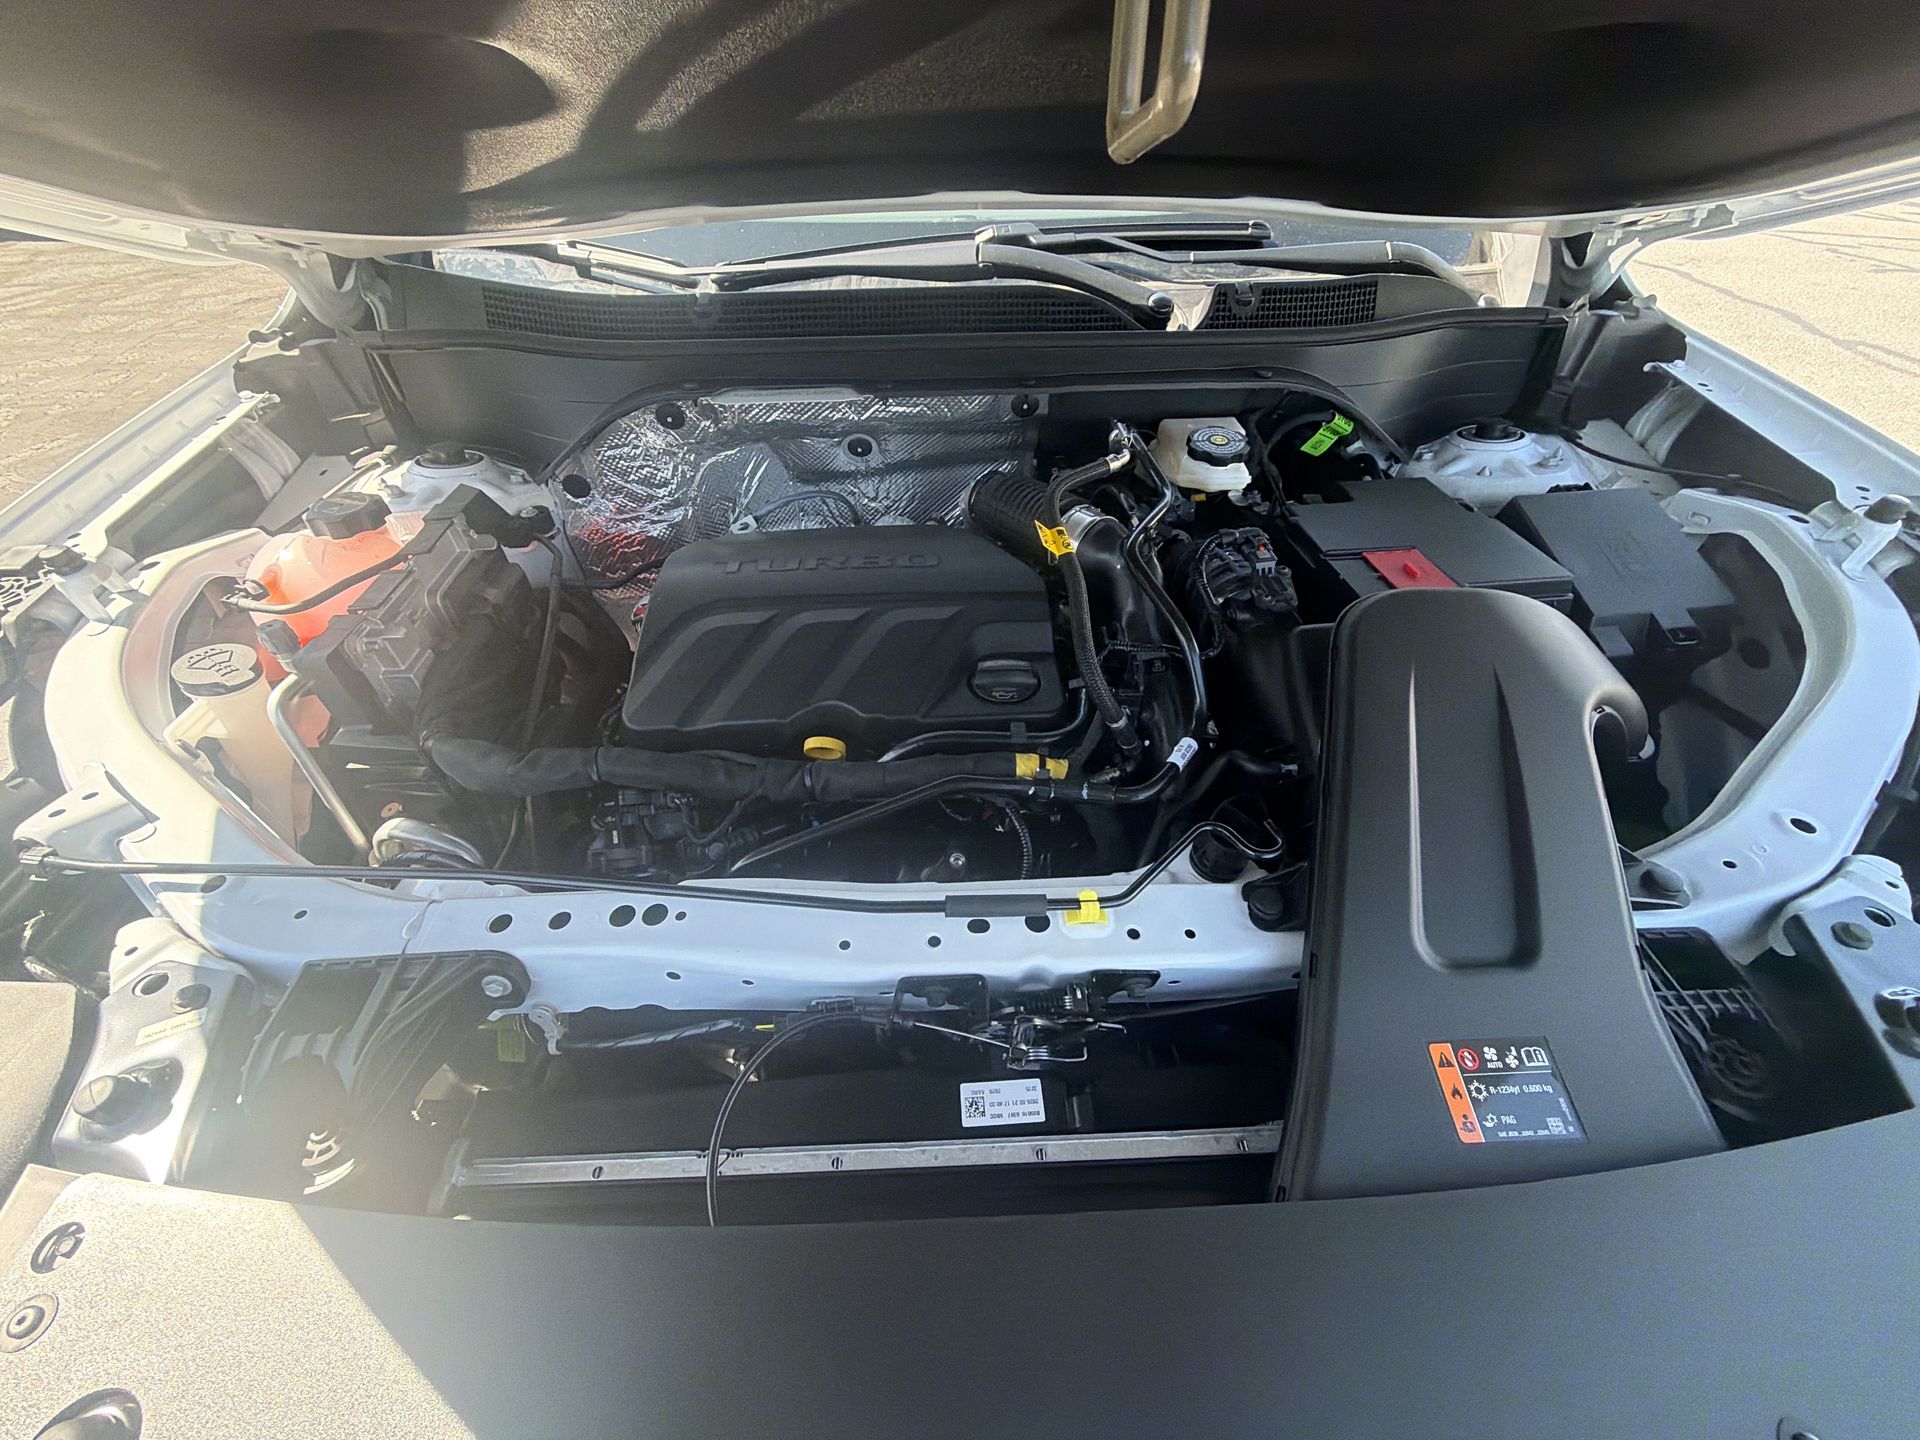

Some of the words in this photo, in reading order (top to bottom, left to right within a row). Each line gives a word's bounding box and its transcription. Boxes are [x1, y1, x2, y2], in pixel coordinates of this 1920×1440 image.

[715, 552, 941, 575] TURBO
[1487, 1061, 1504, 1069] AUTO
[1489, 1085, 1520, 1095] R-1234yf
[1543, 1084, 1553, 1094] kg
[1501, 1116, 1516, 1124] PAG
